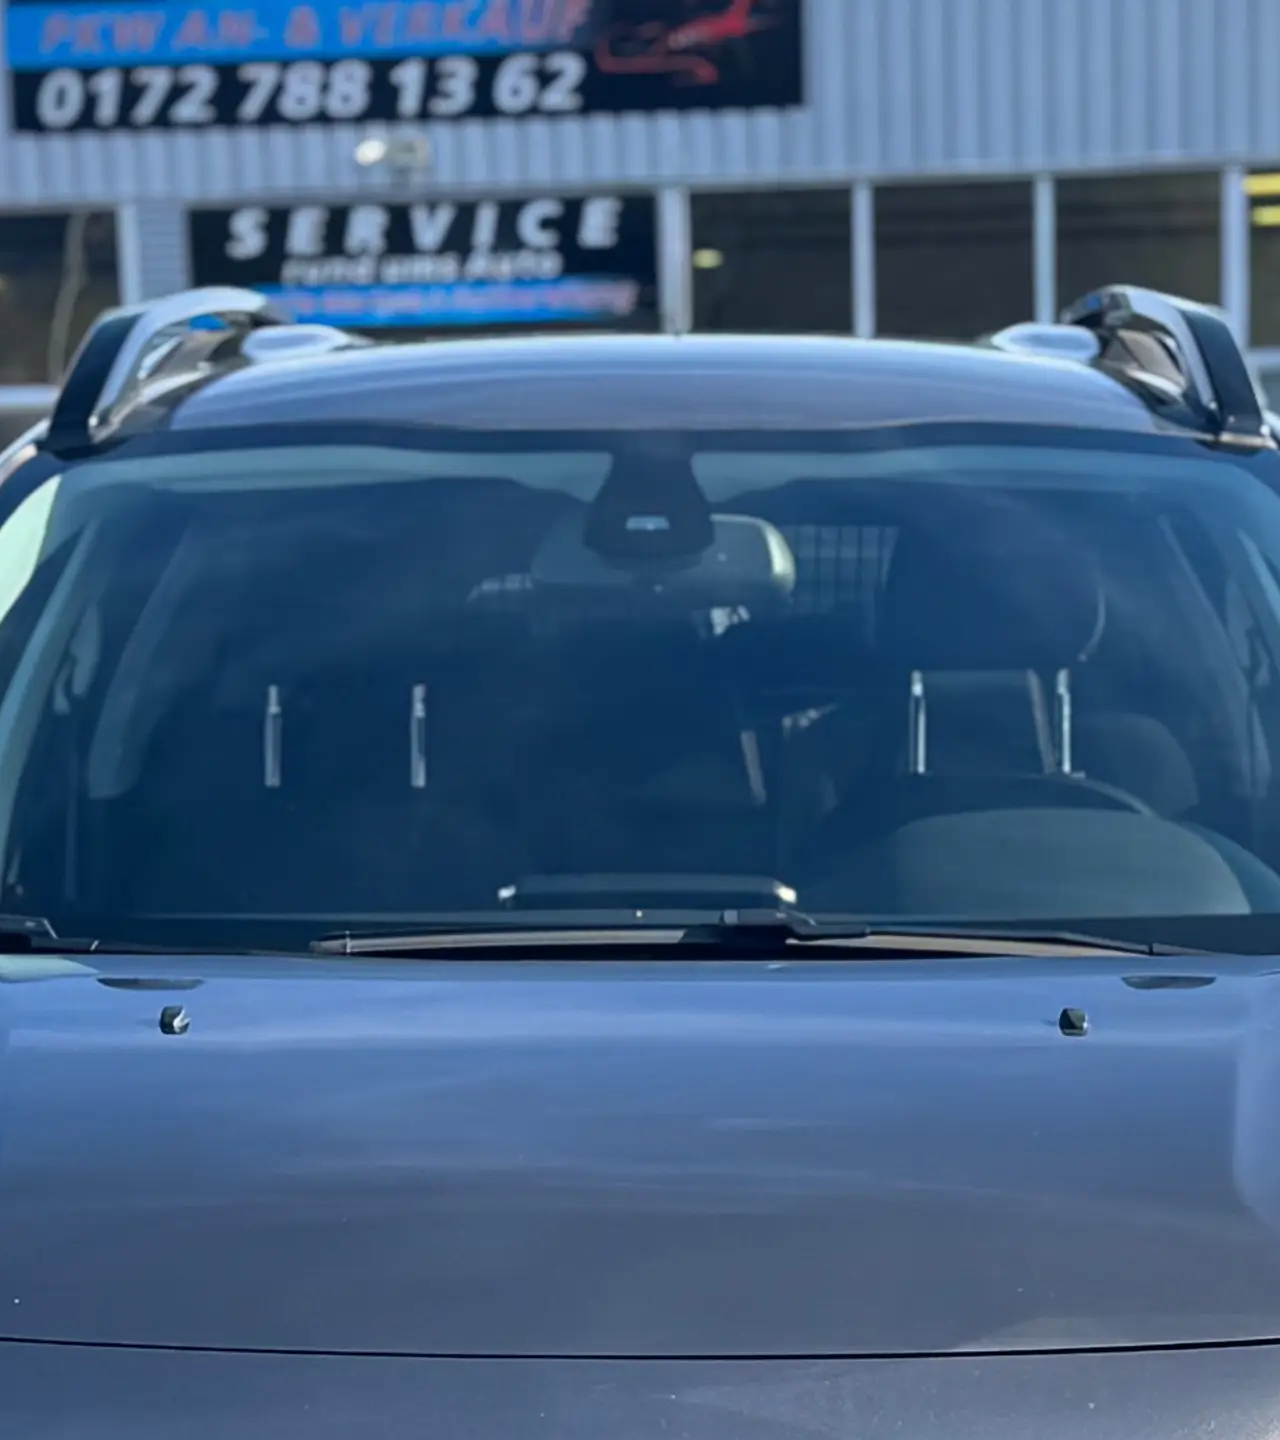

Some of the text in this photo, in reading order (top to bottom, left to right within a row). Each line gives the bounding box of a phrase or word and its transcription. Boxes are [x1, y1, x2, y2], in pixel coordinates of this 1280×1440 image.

[40, 11, 166, 54] PKW
[35, 51, 588, 129] 0172 788 13 62
[225, 197, 624, 260] SERVICE
